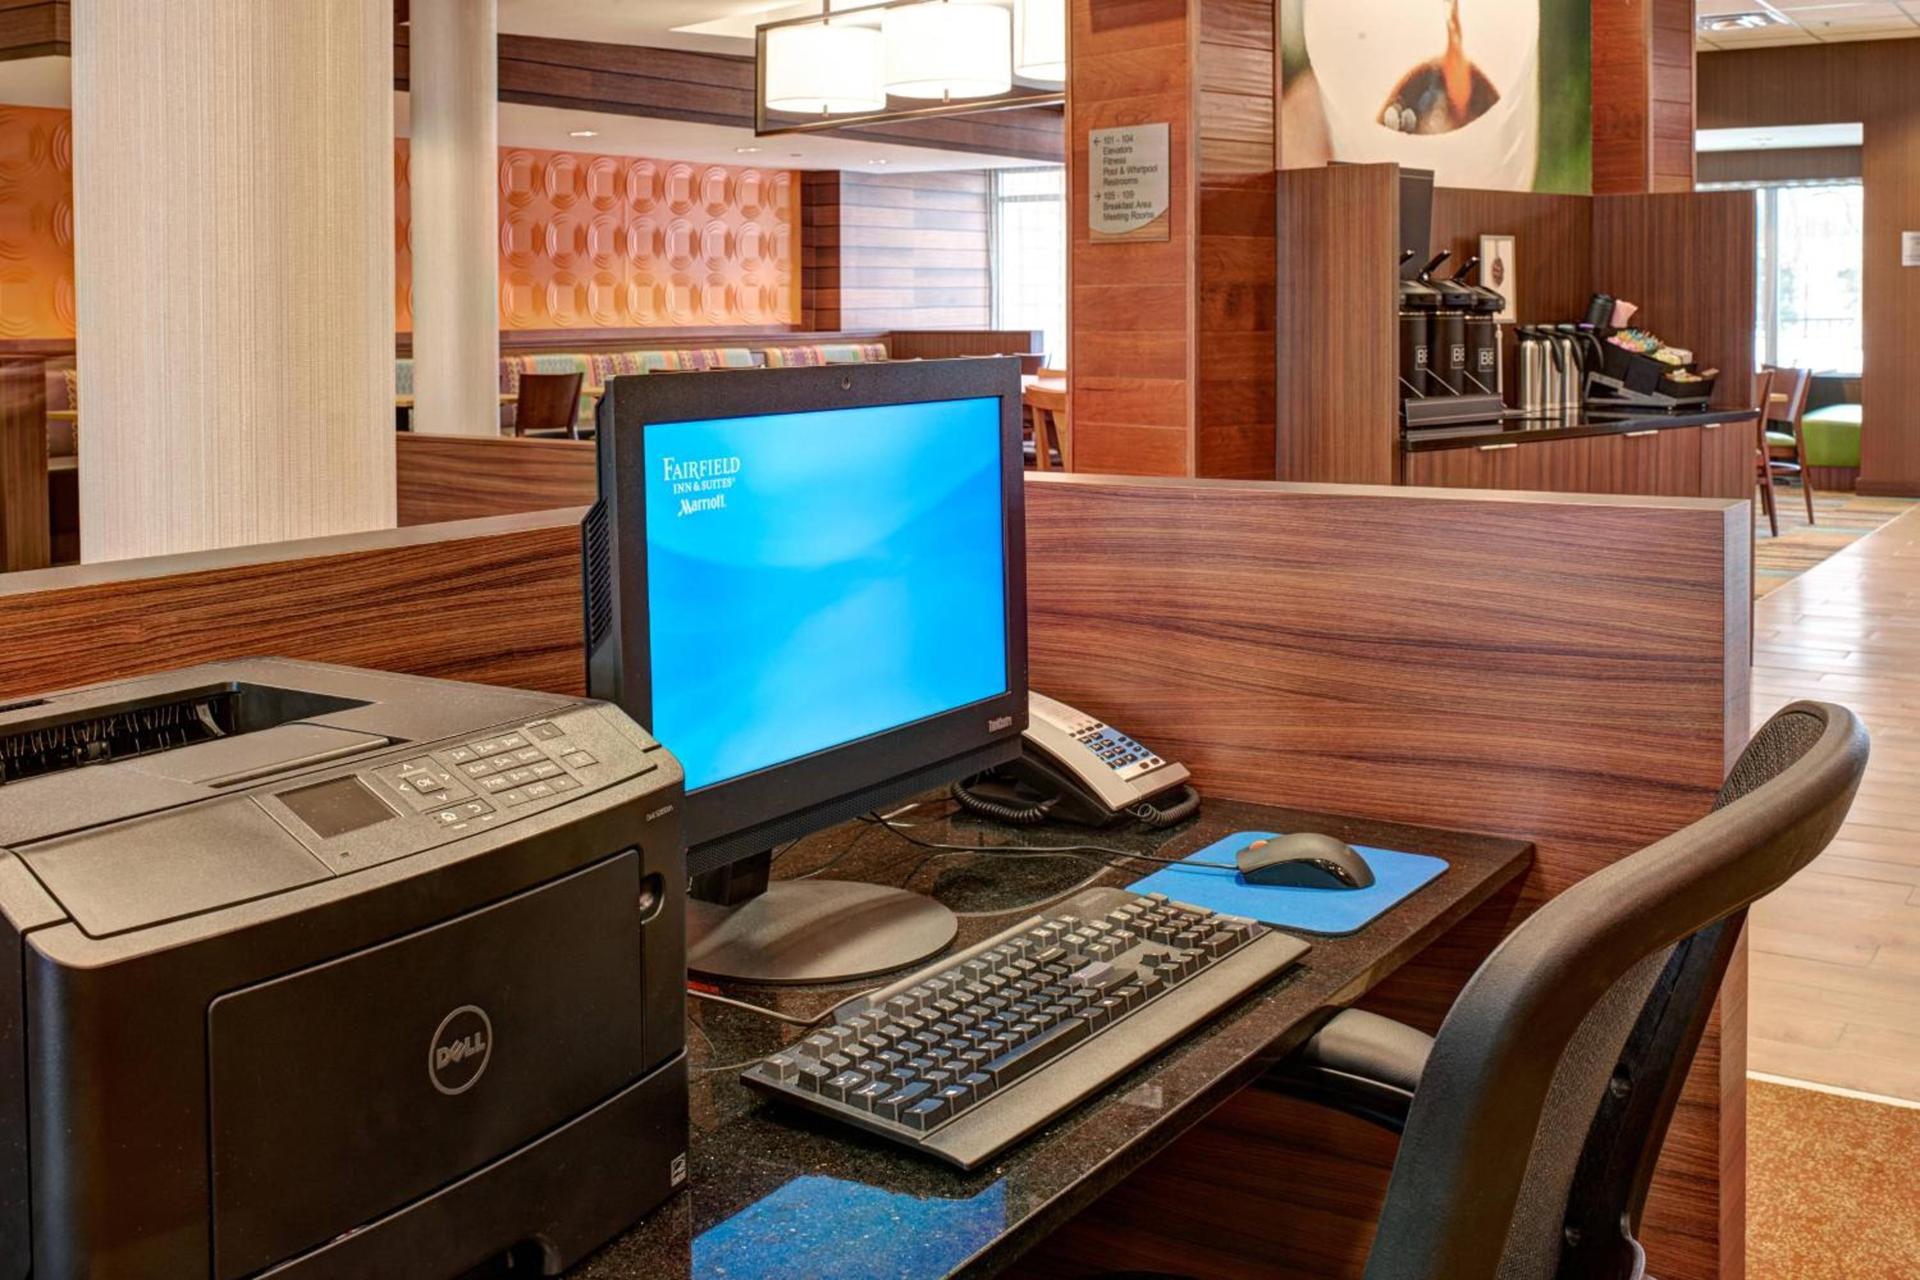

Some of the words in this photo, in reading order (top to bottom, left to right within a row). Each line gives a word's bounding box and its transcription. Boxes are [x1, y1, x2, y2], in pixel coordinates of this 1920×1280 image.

[1103, 136, 1115, 145] 101
[1122, 135, 1134, 144] 104
[1103, 146, 1133, 155] Elevators
[1103, 157, 1127, 165] Fitness
[1103, 167, 1118, 176] Pool
[1119, 166, 1125, 175] &
[1126, 164, 1158, 177] Whirlpool
[1103, 177, 1139, 186] Restrooms
[1103, 201, 1134, 211] Breakfast
[1136, 200, 1152, 209] Area
[1103, 213, 1130, 222] Meeting
[1131, 211, 1154, 220] Rooms
[662, 456, 741, 482] FAIRFIELD
[673, 481, 692, 495] INN
[693, 480, 700, 492] &
[700, 477, 733, 492] SUITES
[677, 494, 727, 518] Marriott
[416, 778, 435, 788] OK
[435, 1031, 487, 1071] DELL
